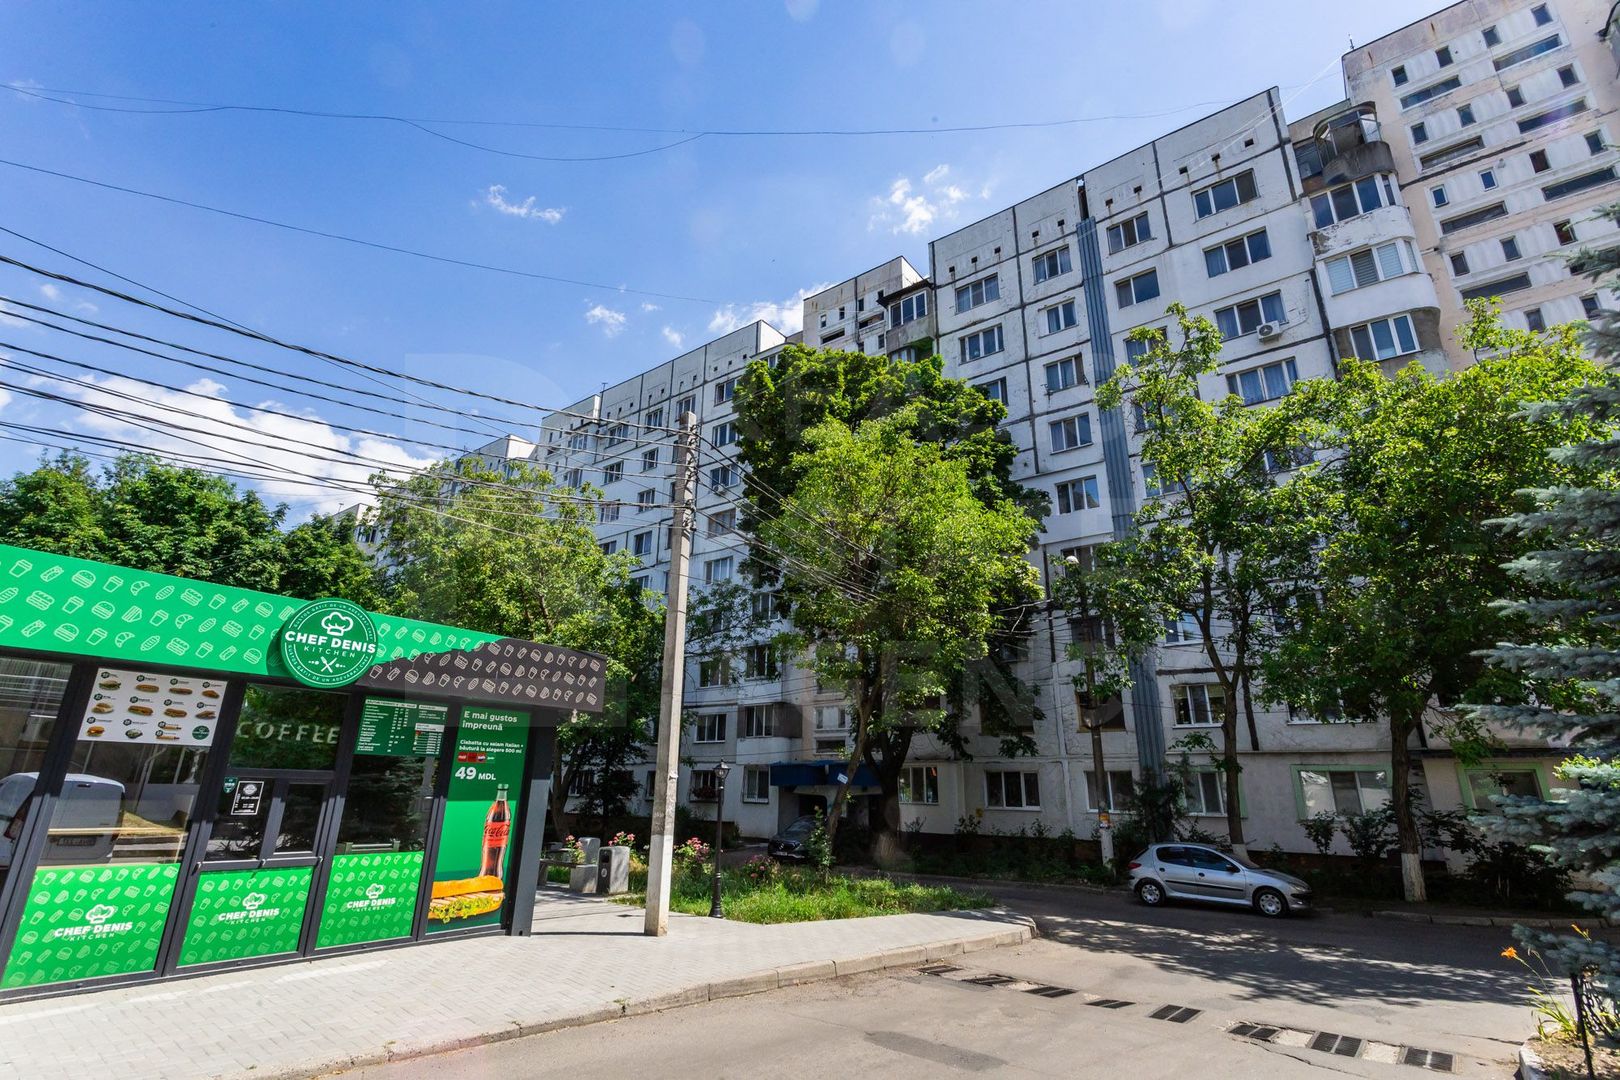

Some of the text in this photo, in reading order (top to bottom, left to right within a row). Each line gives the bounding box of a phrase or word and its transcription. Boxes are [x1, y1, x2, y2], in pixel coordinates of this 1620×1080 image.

[284, 631, 376, 654] CHEF DENIS
[303, 646, 355, 658] KITCHEN
[464, 710, 518, 723] E mai gustos
[235, 721, 341, 745] COFFEE
[455, 766, 477, 780] 49
[346, 897, 396, 908] CHEF DENIS
[218, 908, 280, 921] CHEF DENIS
[54, 921, 133, 937] CHEF DENIS
[69, 932, 115, 941] KITCHEN
